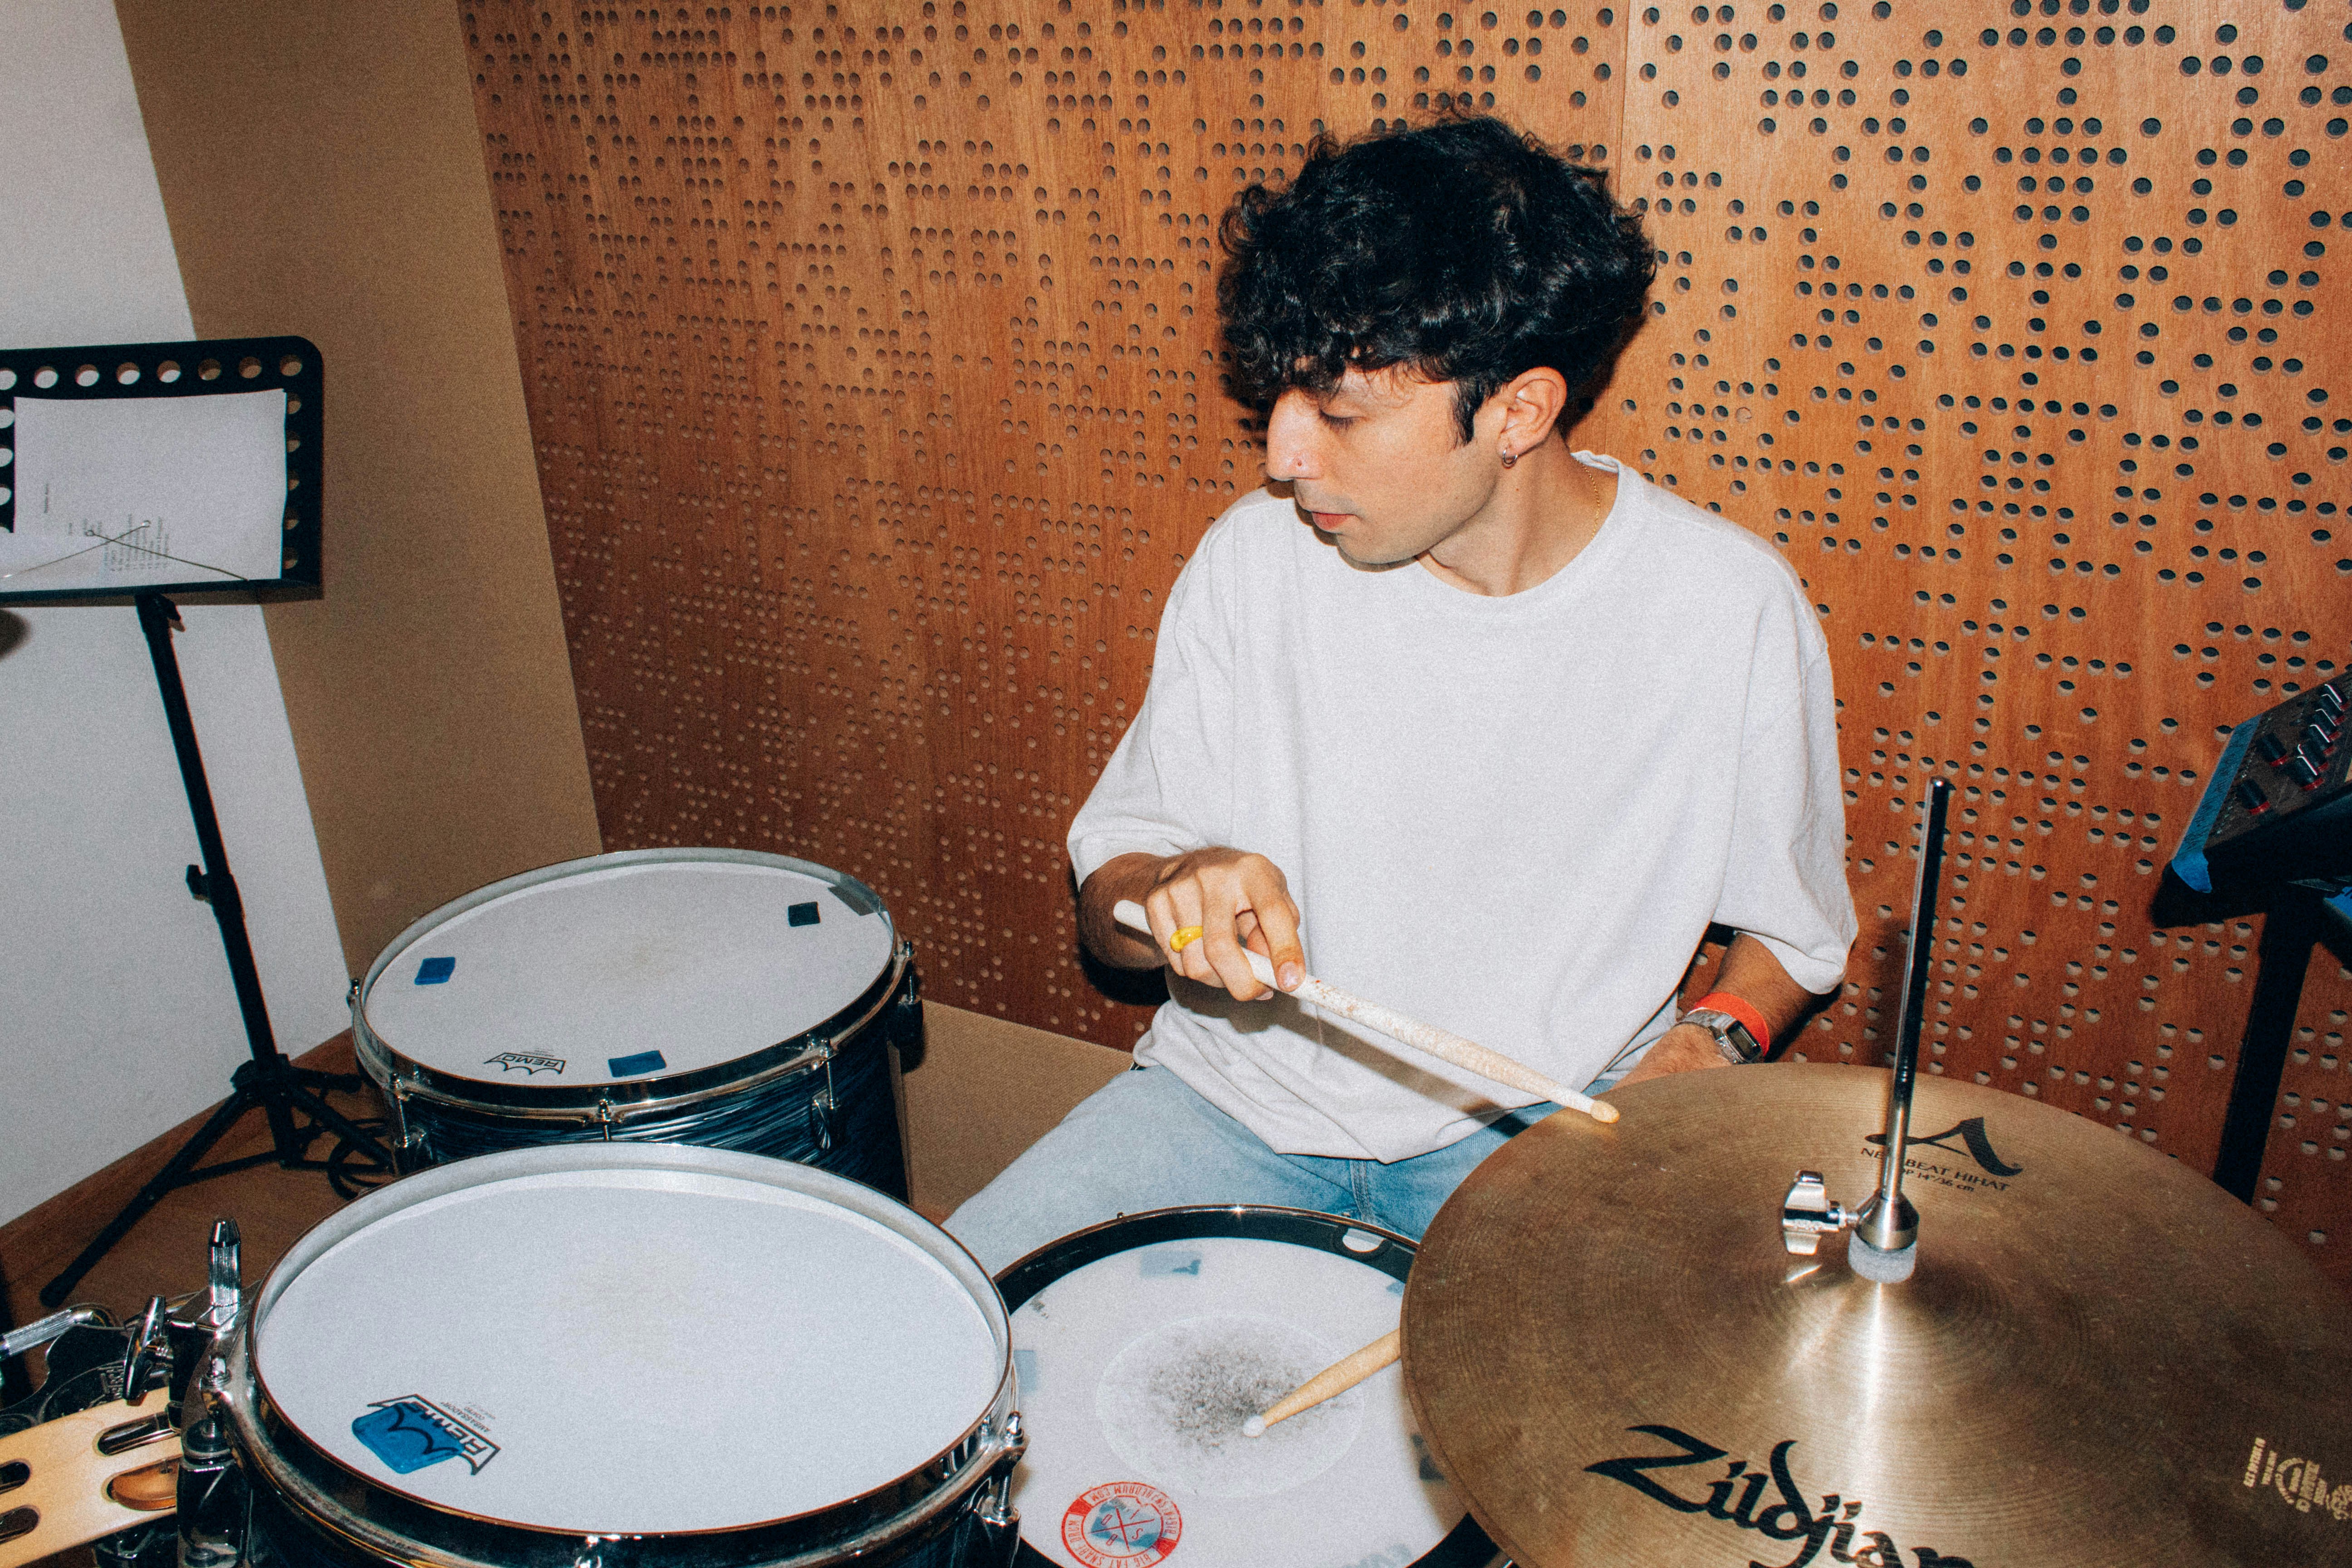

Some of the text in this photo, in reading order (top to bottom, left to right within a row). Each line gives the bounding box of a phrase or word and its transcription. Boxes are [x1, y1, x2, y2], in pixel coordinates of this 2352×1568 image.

[502, 1055, 559, 1067] REMO
[1861, 1147, 1883, 1159] NE
[1906, 1159, 1949, 1176] BEAT
[1954, 1171, 2010, 1191] HIHAT
[1136, 1554, 1152, 1567] BIG
